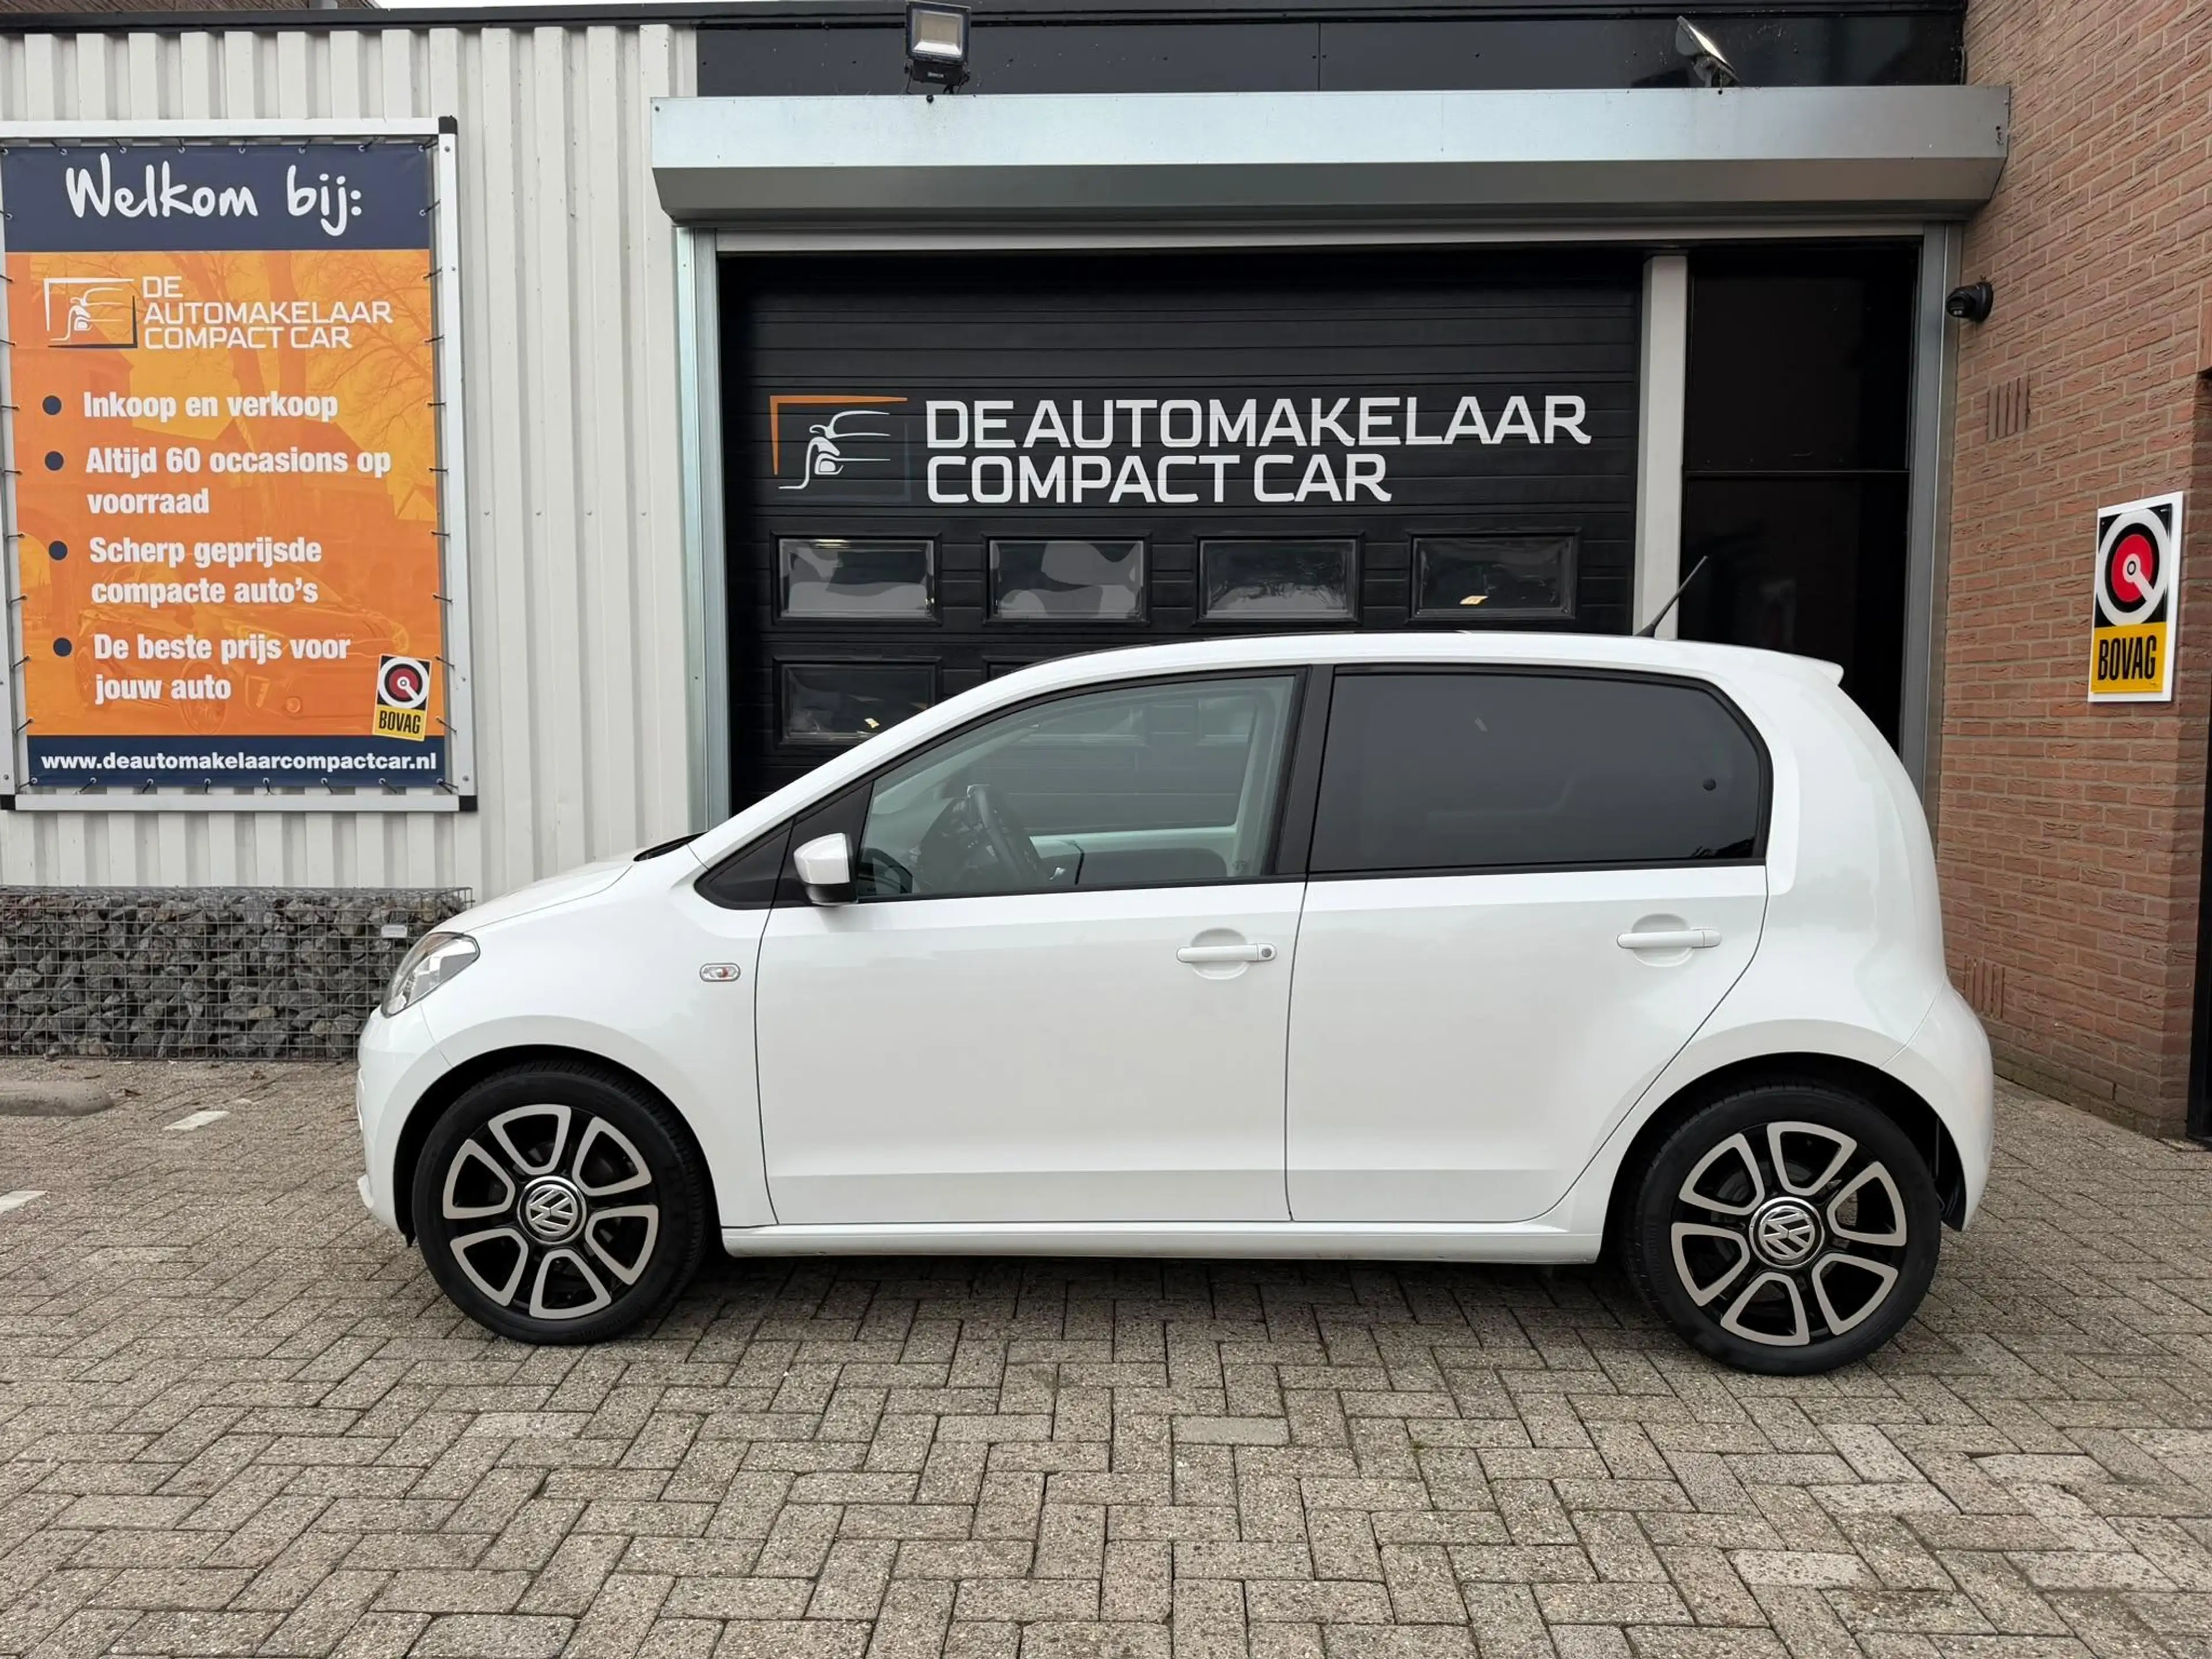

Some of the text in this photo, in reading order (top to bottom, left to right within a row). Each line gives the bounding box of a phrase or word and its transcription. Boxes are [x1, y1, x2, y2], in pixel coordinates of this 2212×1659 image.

[66, 152, 362, 236] Welkom bij:
[142, 275, 184, 299] DE
[143, 301, 394, 326] AUTOMAKELAAR
[144, 326, 353, 350] COMPACT CAR
[84, 391, 339, 423] Inkoop en verkoop
[85, 446, 392, 479] Altijd 60 occasions op
[927, 453, 1392, 503] COMPACT CAR
[86, 487, 210, 514] voorraad
[89, 536, 322, 569] Scherp geprijsde
[91, 577, 319, 609] compacte auto's
[94, 633, 351, 665] De beste prijs voor
[2097, 634, 2157, 681] BOVAG
[95, 674, 232, 705] jouw auto
[378, 710, 421, 734] BOVAG
[41, 752, 436, 772] www.deautomakelaarcompactcar.nl
